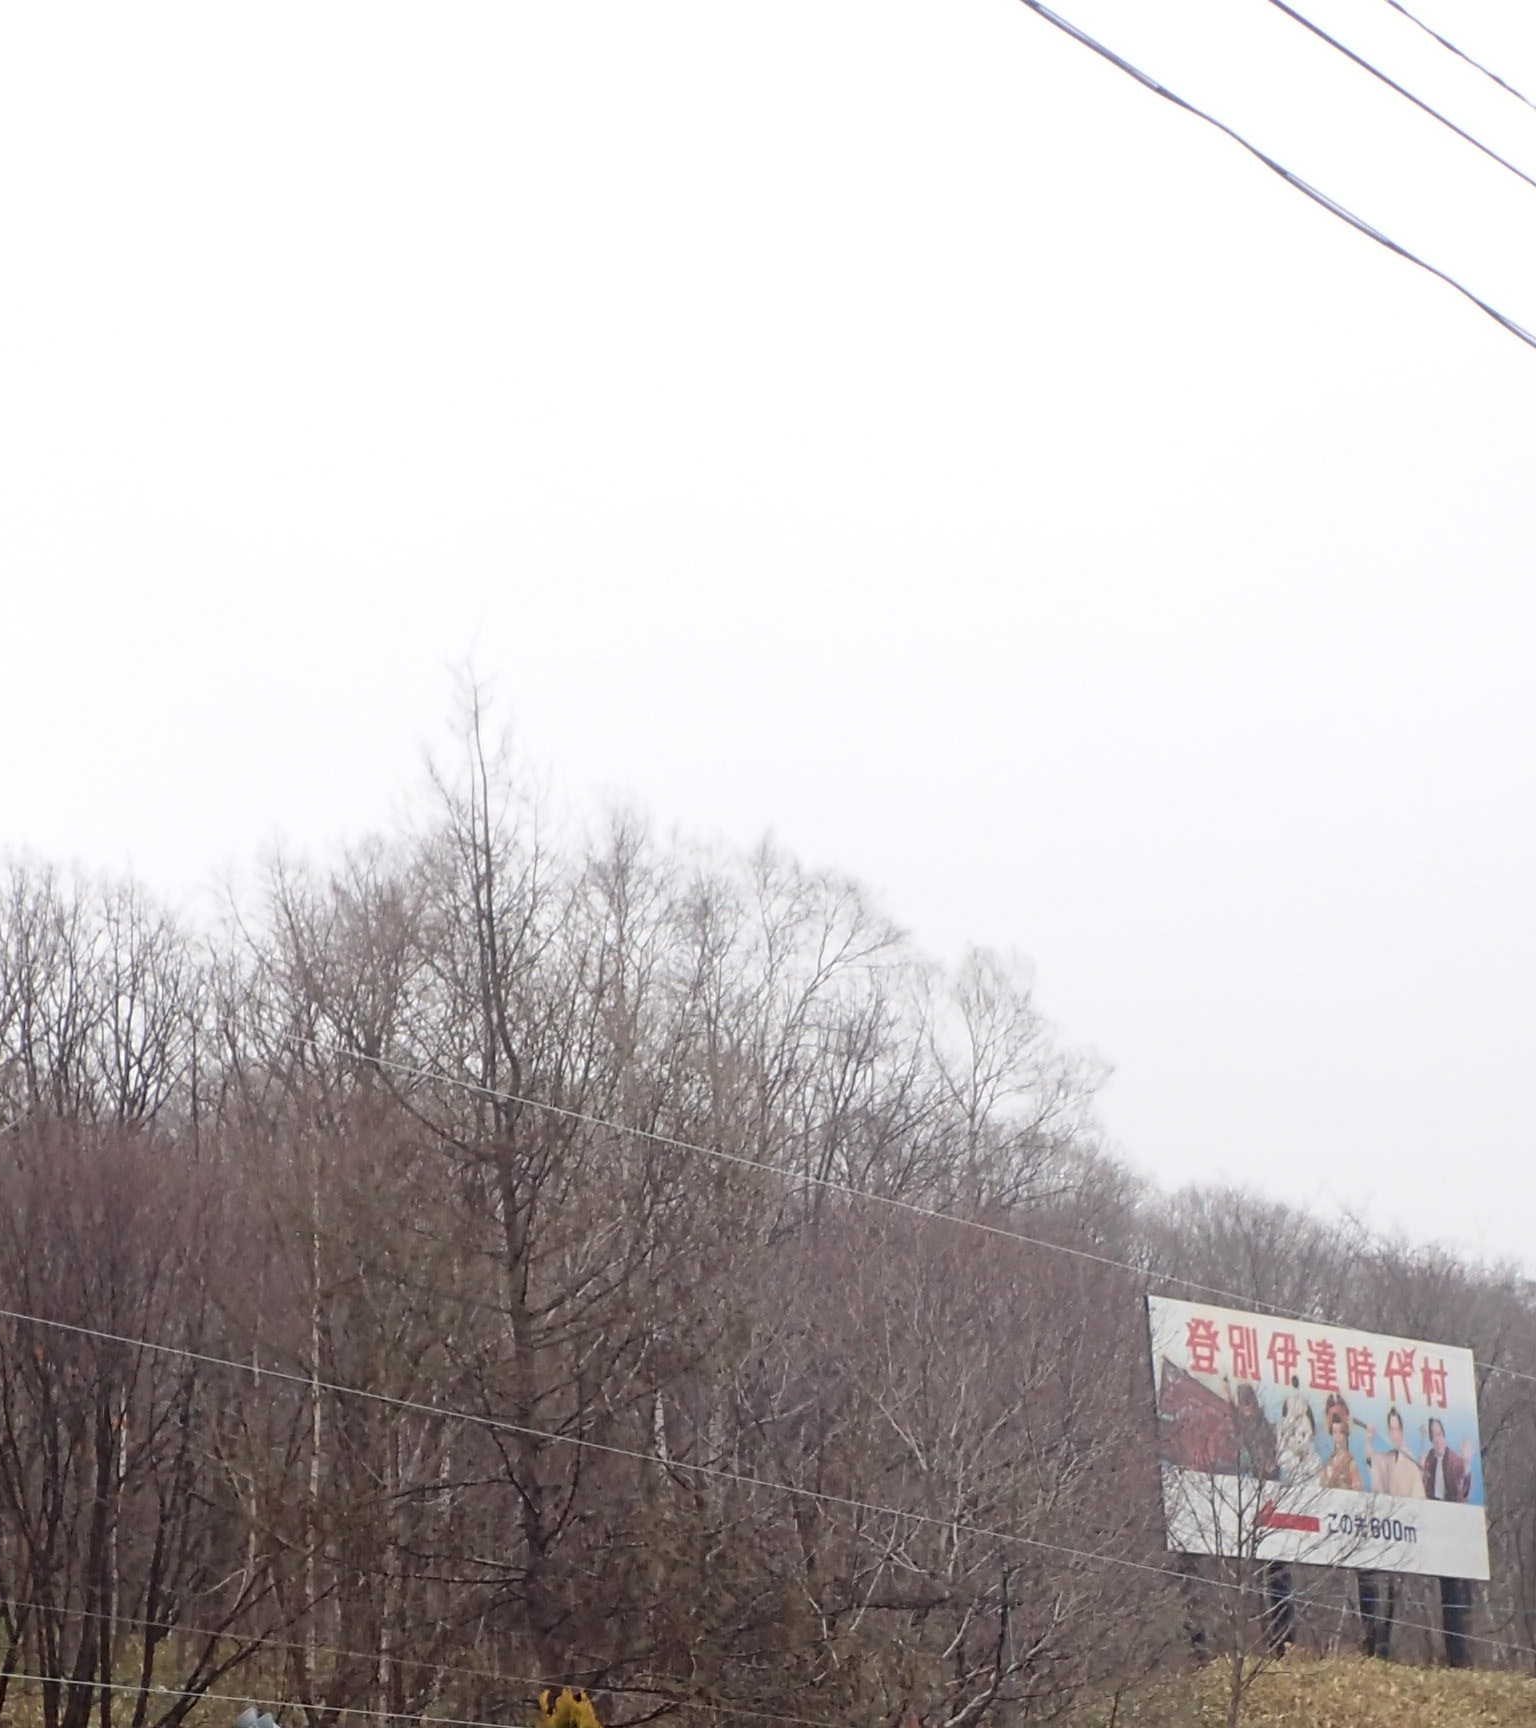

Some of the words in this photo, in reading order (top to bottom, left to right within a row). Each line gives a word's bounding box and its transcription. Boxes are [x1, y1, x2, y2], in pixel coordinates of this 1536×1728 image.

[1185, 1317, 1449, 1410] 登別伊達時代村
